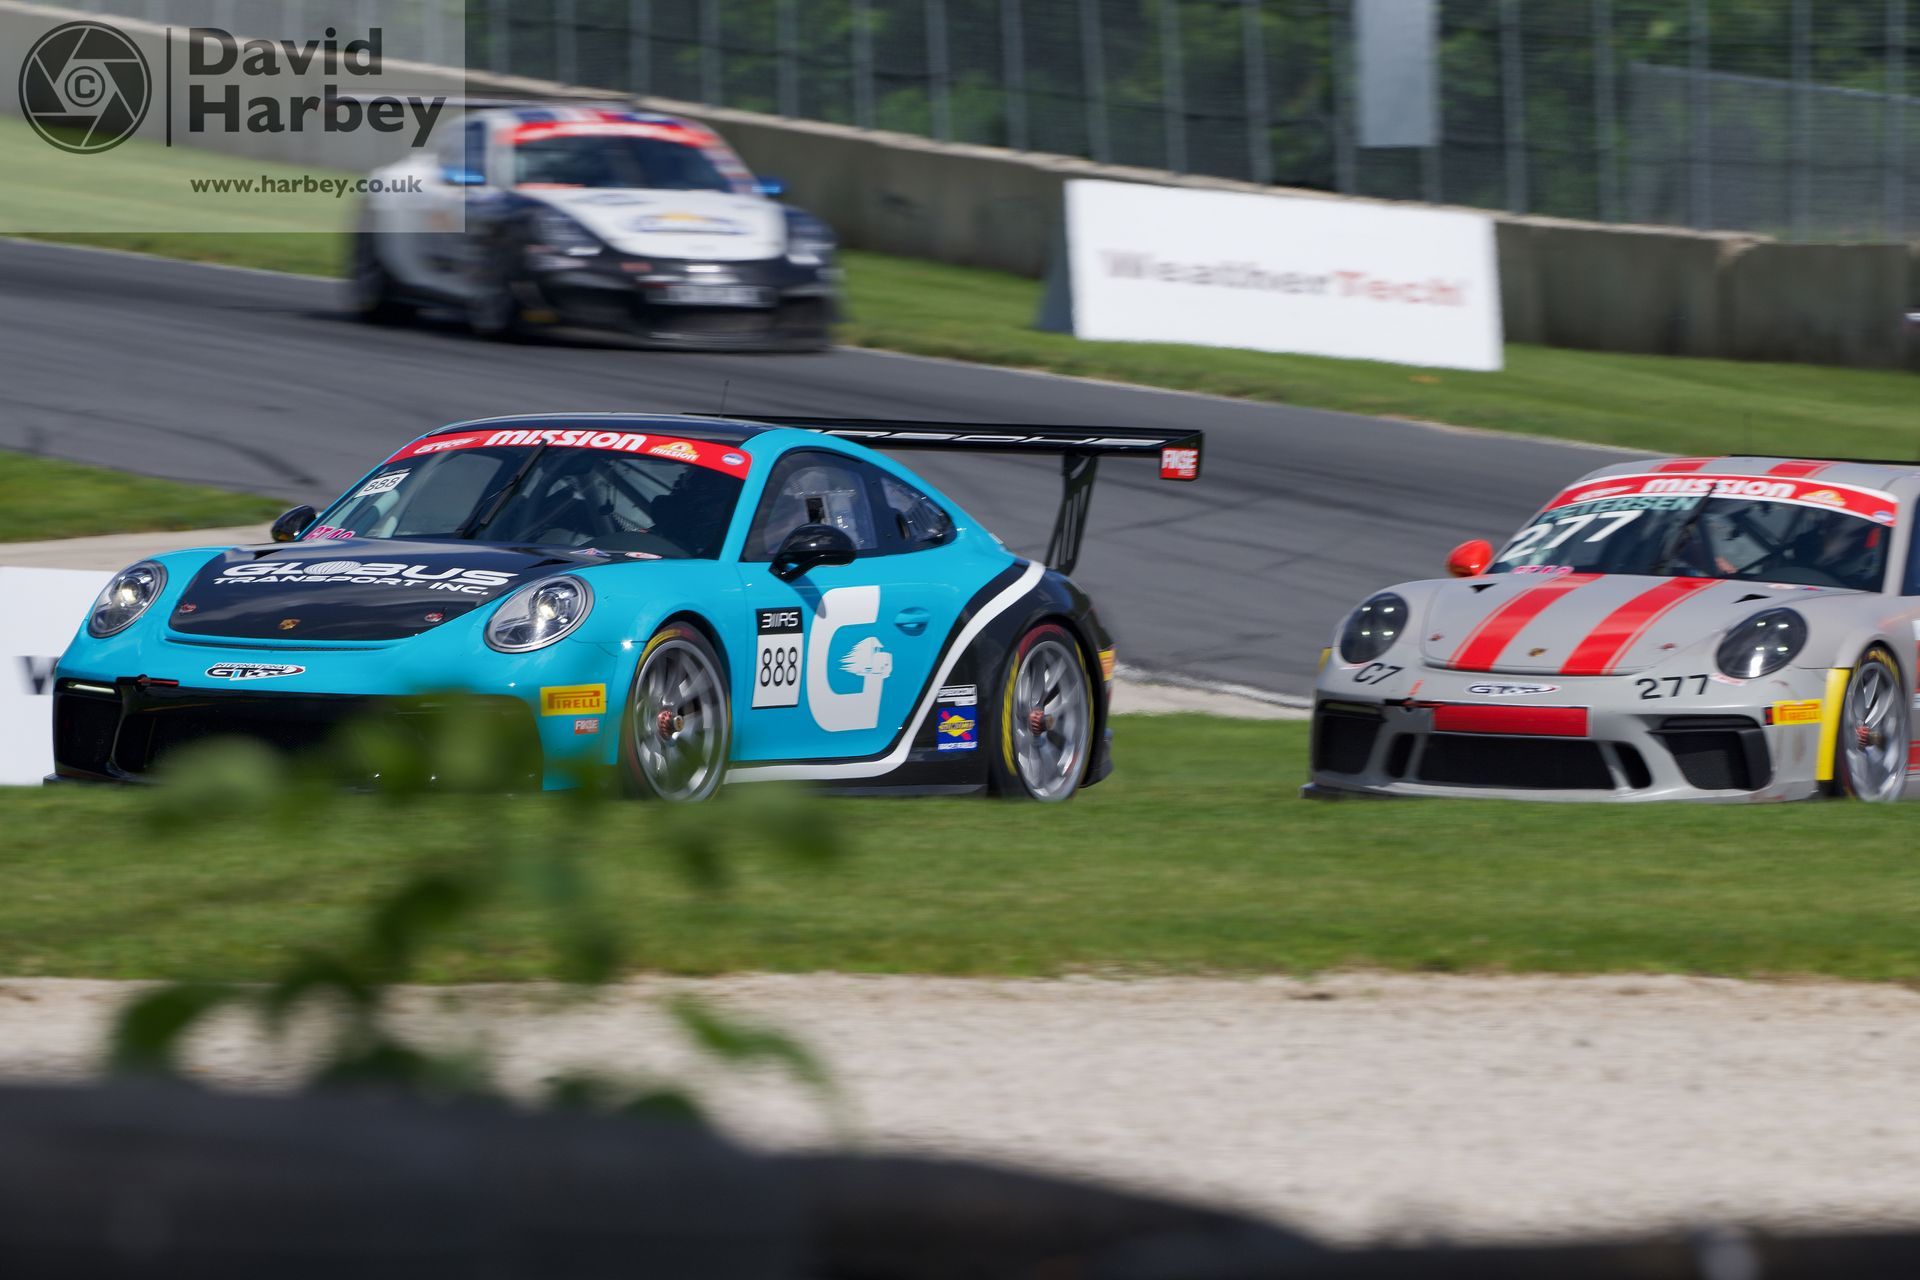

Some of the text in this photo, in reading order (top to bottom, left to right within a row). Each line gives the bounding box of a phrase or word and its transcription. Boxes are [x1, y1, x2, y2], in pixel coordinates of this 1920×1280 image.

[363, 476, 401, 492] 888
[1499, 509, 1646, 563] 277
[213, 575, 490, 596] TRANSPORT INC.
[222, 560, 519, 588] GLOBUS
[760, 646, 798, 687] 888
[1353, 662, 1405, 685] C7
[1635, 674, 1709, 700] 277
[547, 690, 601, 710] PIRELLI
[1779, 703, 1820, 721] PIRELLI
